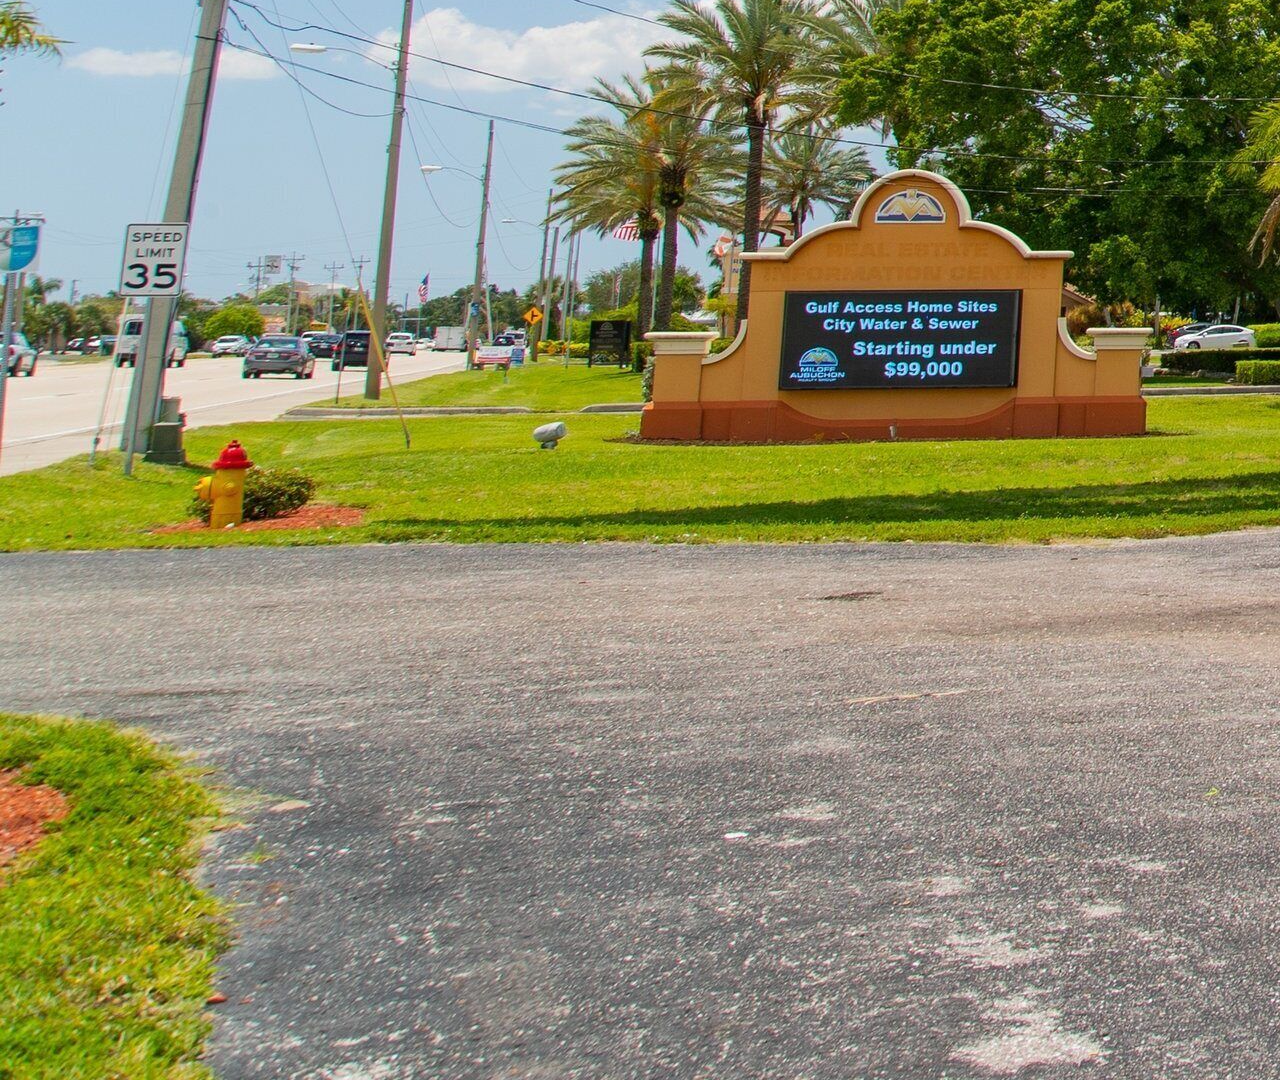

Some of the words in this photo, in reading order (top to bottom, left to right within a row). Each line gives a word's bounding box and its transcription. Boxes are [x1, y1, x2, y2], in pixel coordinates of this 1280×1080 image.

[132, 232, 183, 243] SPEED
[135, 248, 175, 258] LIMIT
[124, 263, 177, 289] 35
[805, 301, 840, 314] Gulf
[843, 301, 903, 314] Access
[907, 301, 953, 314] Home
[957, 300, 998, 313] Sites
[823, 318, 855, 333] City
[860, 318, 907, 331] Water
[911, 318, 923, 330] &
[928, 317, 979, 330] Sewer
[853, 341, 934, 358] Starting
[940, 340, 997, 355] under
[884, 361, 963, 379] $99,000
